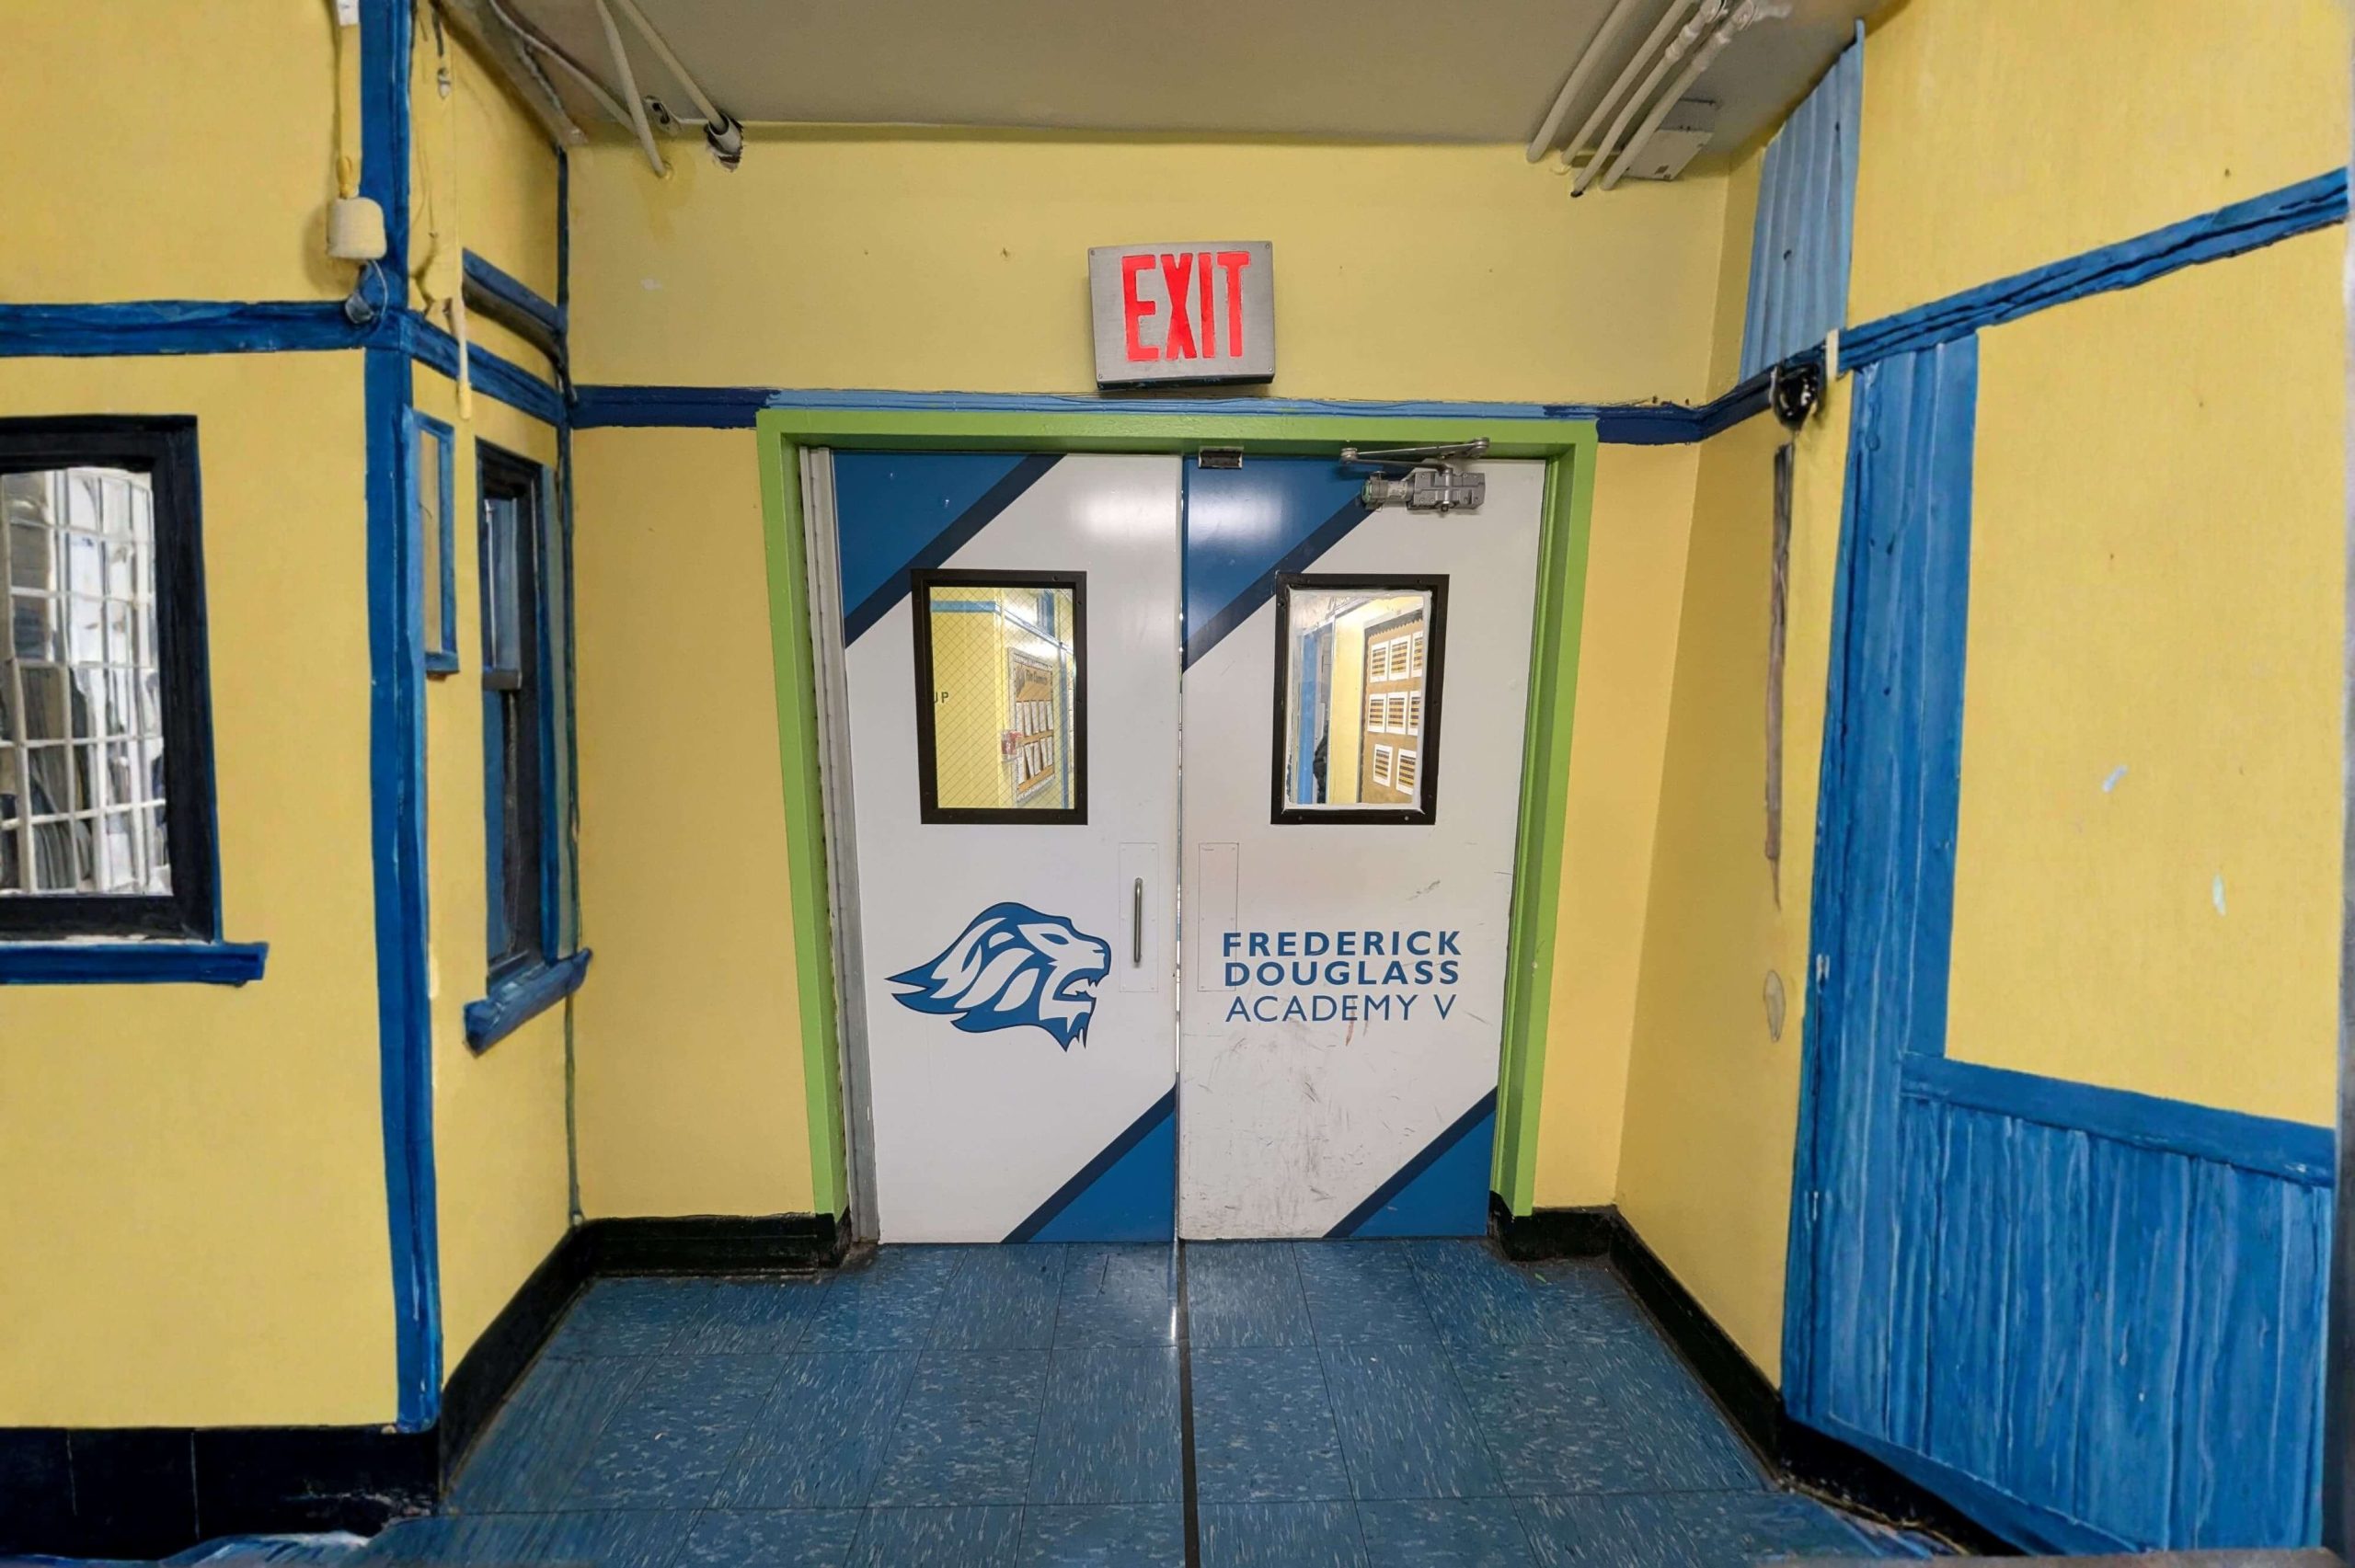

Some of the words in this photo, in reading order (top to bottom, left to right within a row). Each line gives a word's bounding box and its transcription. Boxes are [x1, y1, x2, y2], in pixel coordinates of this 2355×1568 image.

[1121, 250, 1251, 361] EXIT
[1223, 931, 1461, 956] FREDERICK
[1224, 960, 1459, 987] DOUGLASS
[1225, 994, 1418, 1022] ACADEMY
[1433, 994, 1457, 1020] V
